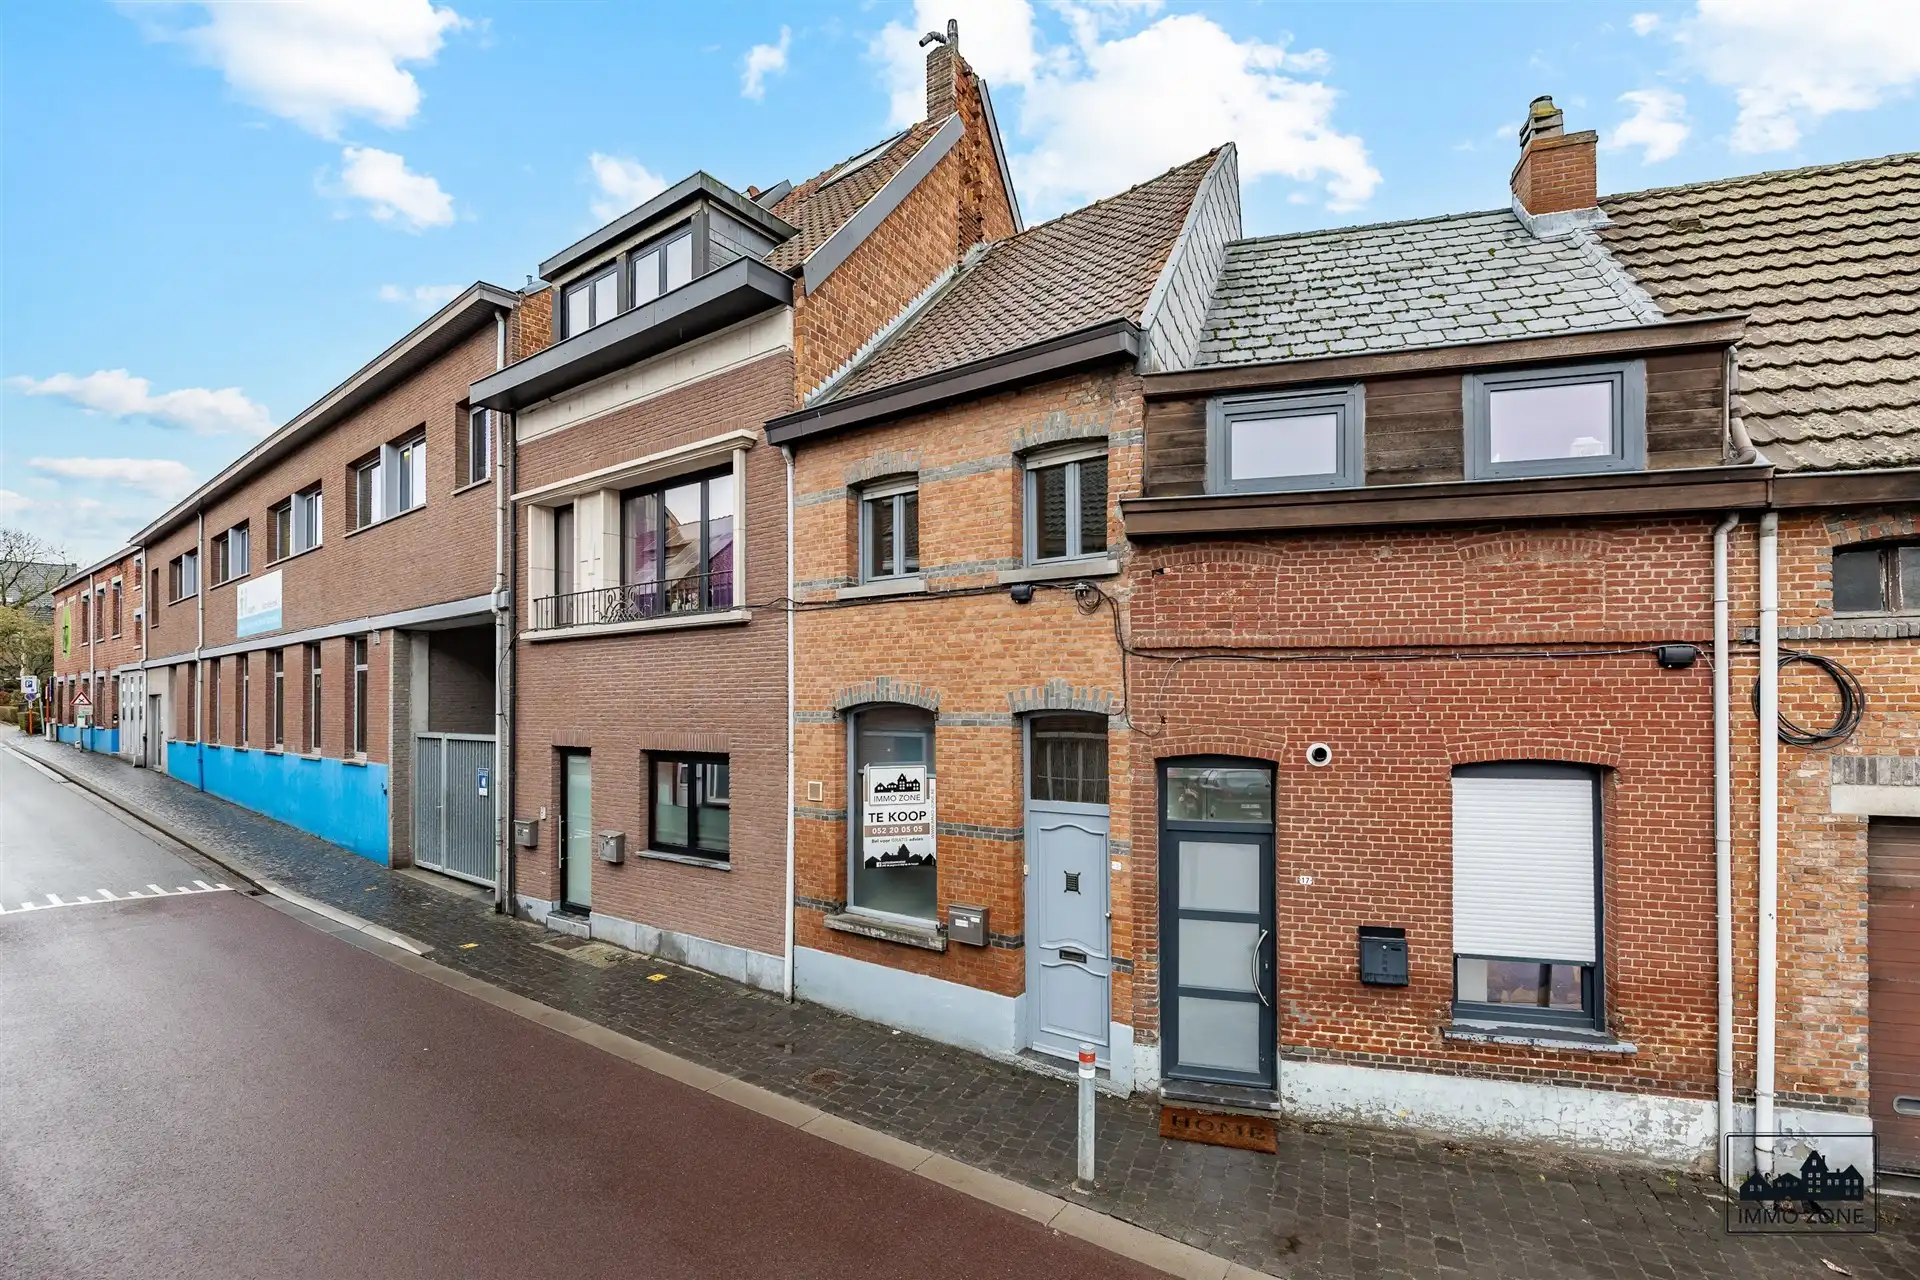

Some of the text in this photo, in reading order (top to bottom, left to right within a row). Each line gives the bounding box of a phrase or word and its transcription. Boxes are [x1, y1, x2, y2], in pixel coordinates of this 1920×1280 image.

[873, 794, 921, 803] IMMO ZONE
[868, 811, 927, 823] TE KOOP
[872, 827, 887, 835] 052
[913, 825, 923, 833] 05
[1172, 1115, 1267, 1140] HOME
